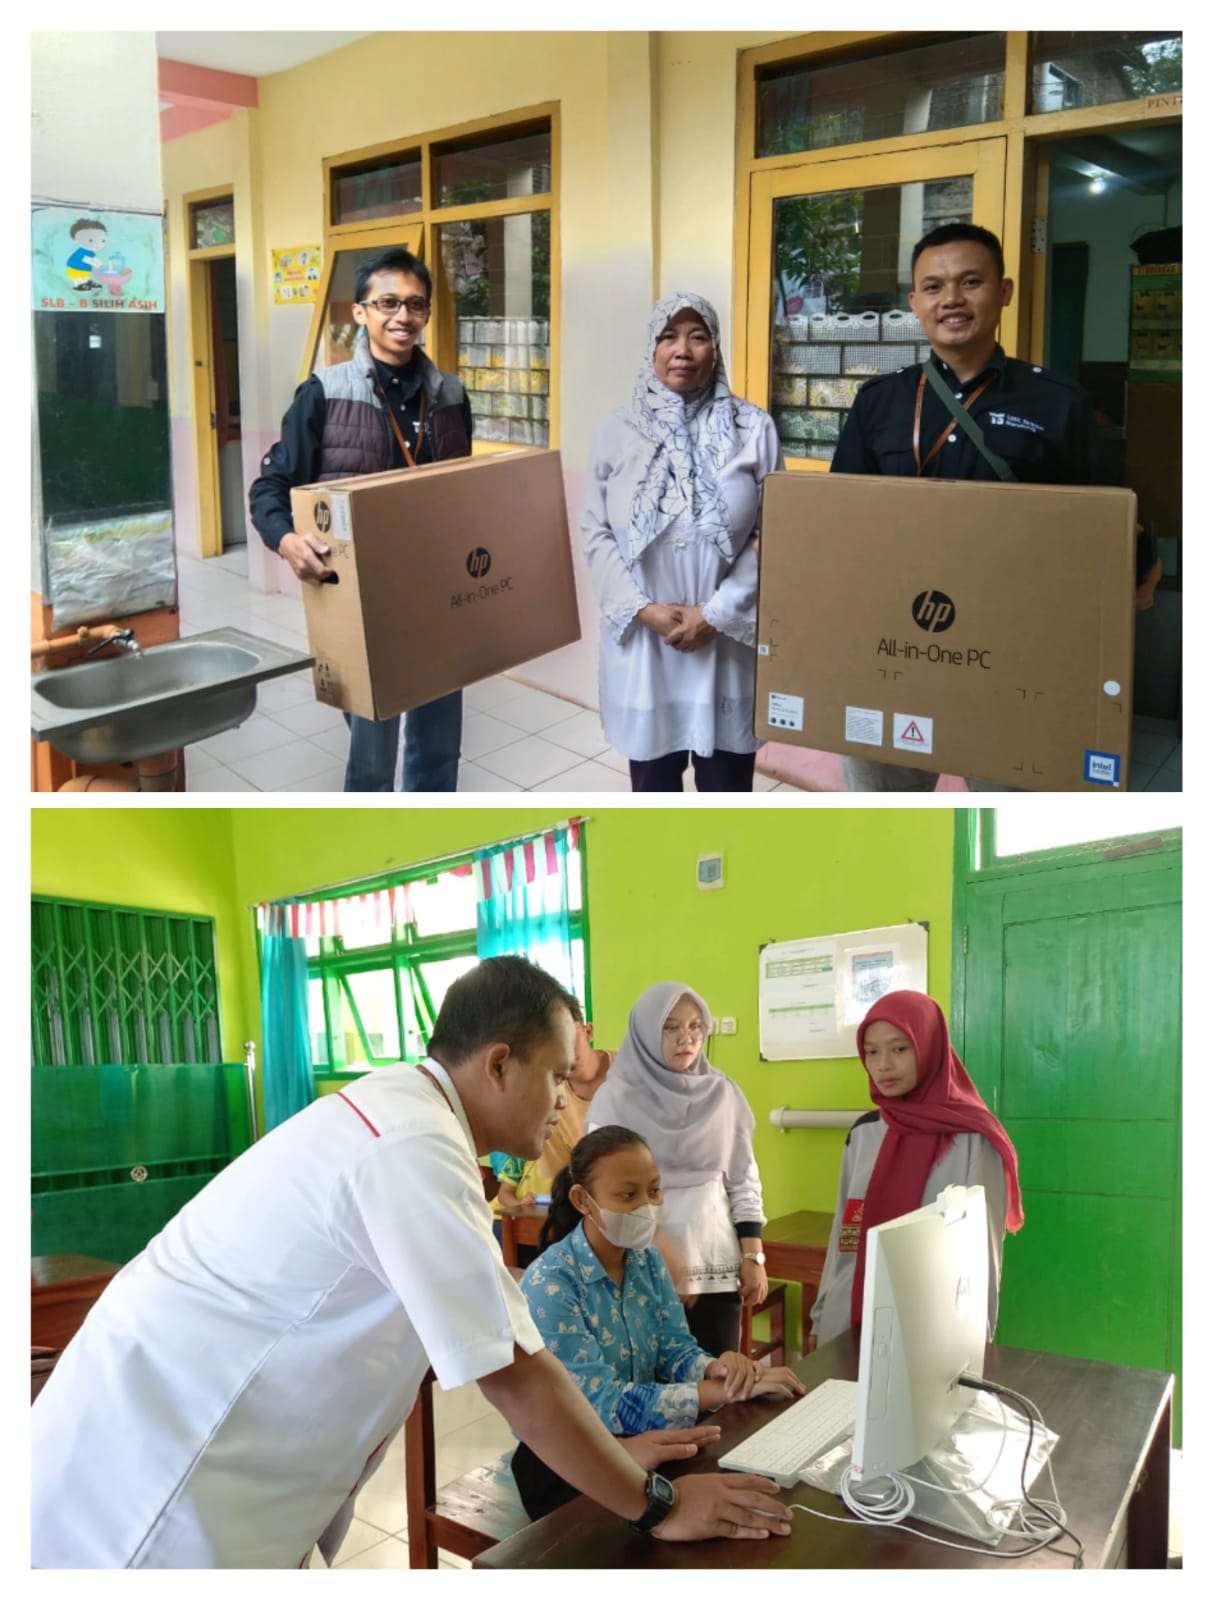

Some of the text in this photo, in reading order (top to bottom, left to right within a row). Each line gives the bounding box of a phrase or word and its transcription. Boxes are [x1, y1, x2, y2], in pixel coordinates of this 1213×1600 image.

[41, 298, 65, 307] SLB
[92, 299, 124, 309] SILIH
[127, 299, 157, 310] ASIH
[314, 500, 331, 533] hp
[466, 547, 491, 578] hp
[451, 576, 513, 609] All-in-One PC
[912, 590, 955, 633] hp
[877, 638, 991, 670] All-in-One PC
